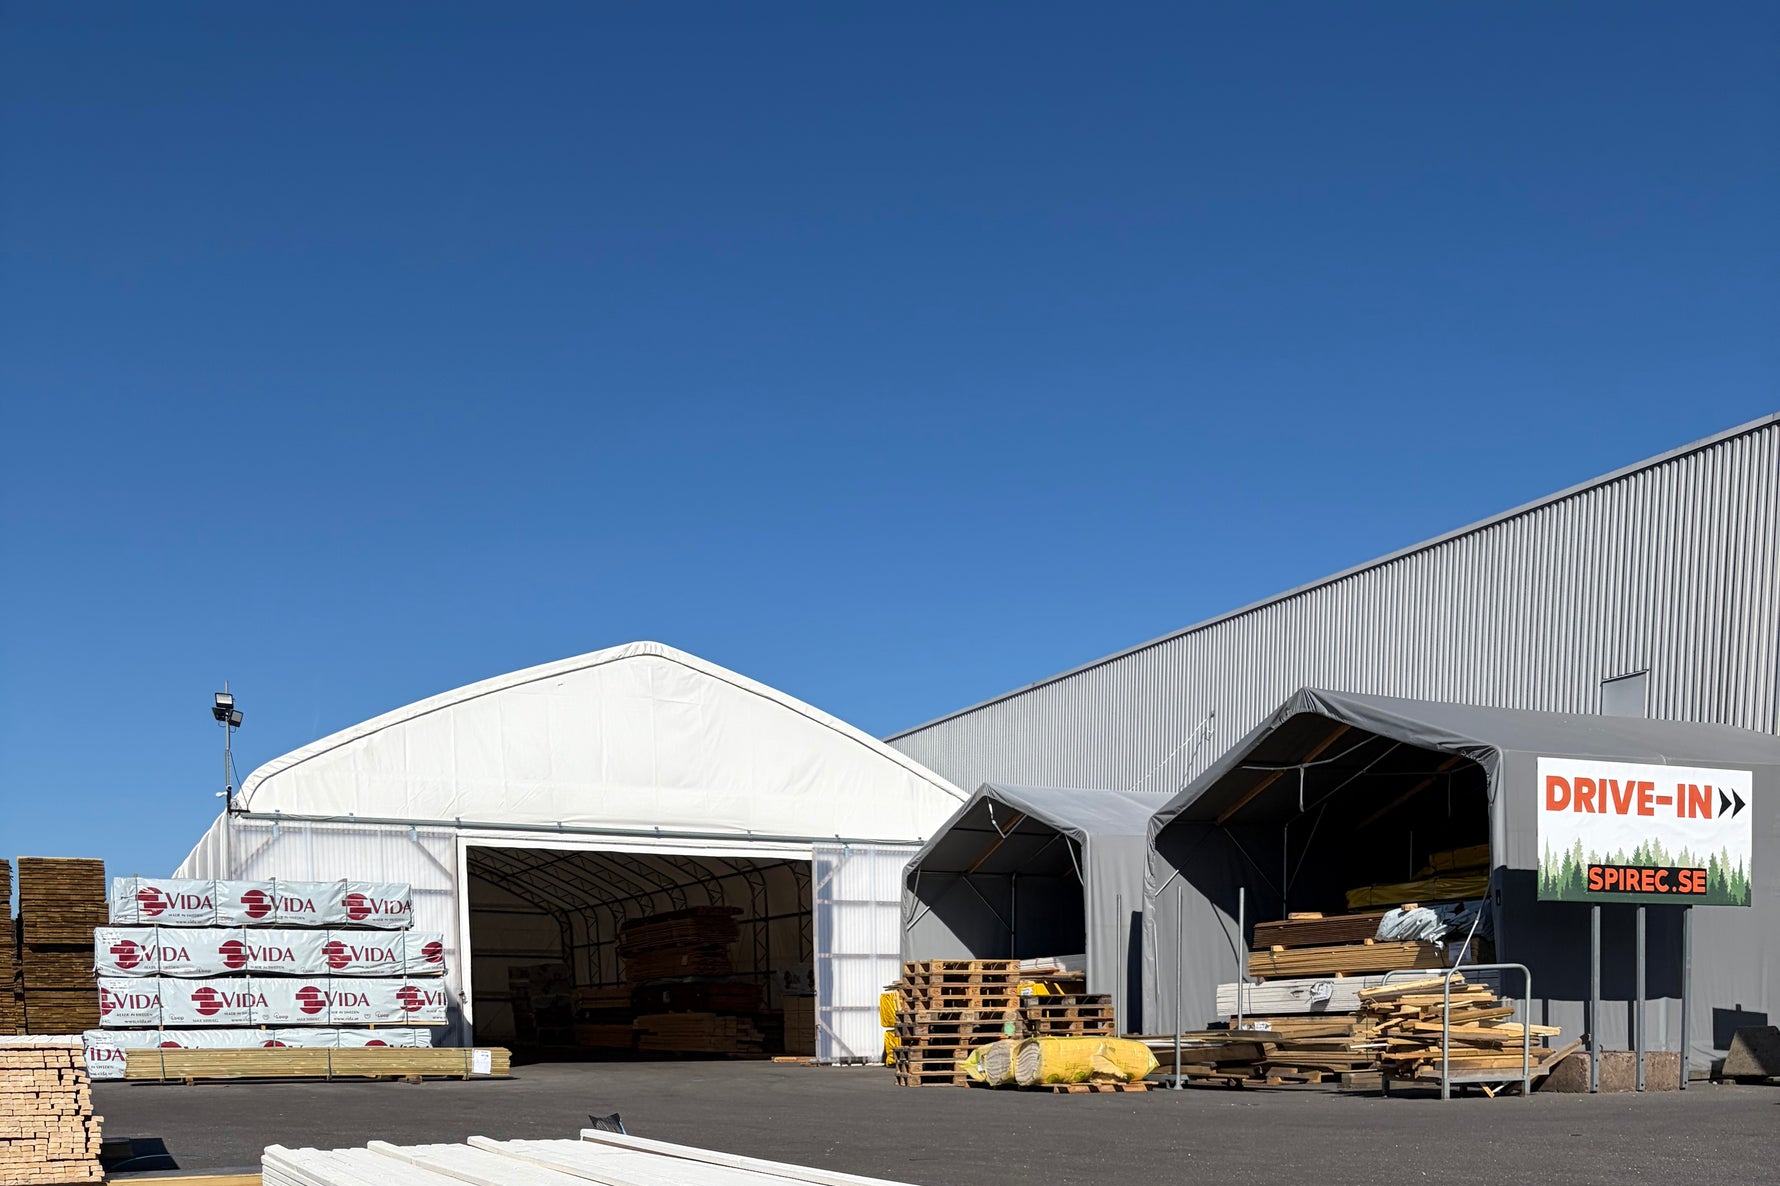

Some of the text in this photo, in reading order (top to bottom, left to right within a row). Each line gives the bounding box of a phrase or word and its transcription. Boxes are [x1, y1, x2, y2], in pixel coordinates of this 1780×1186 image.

[1545, 775, 1713, 820] DRIVE-IN
[1588, 867, 1706, 894] SPIREC.SE
[165, 892, 213, 910] VIDA
[269, 895, 316, 913] VIDA
[369, 898, 411, 914] VIDA
[247, 945, 295, 962] VIDA
[349, 945, 396, 962] VIDA
[114, 993, 163, 1009] VIDA
[220, 991, 268, 1008] VIDA
[324, 991, 370, 1007] VIDA
